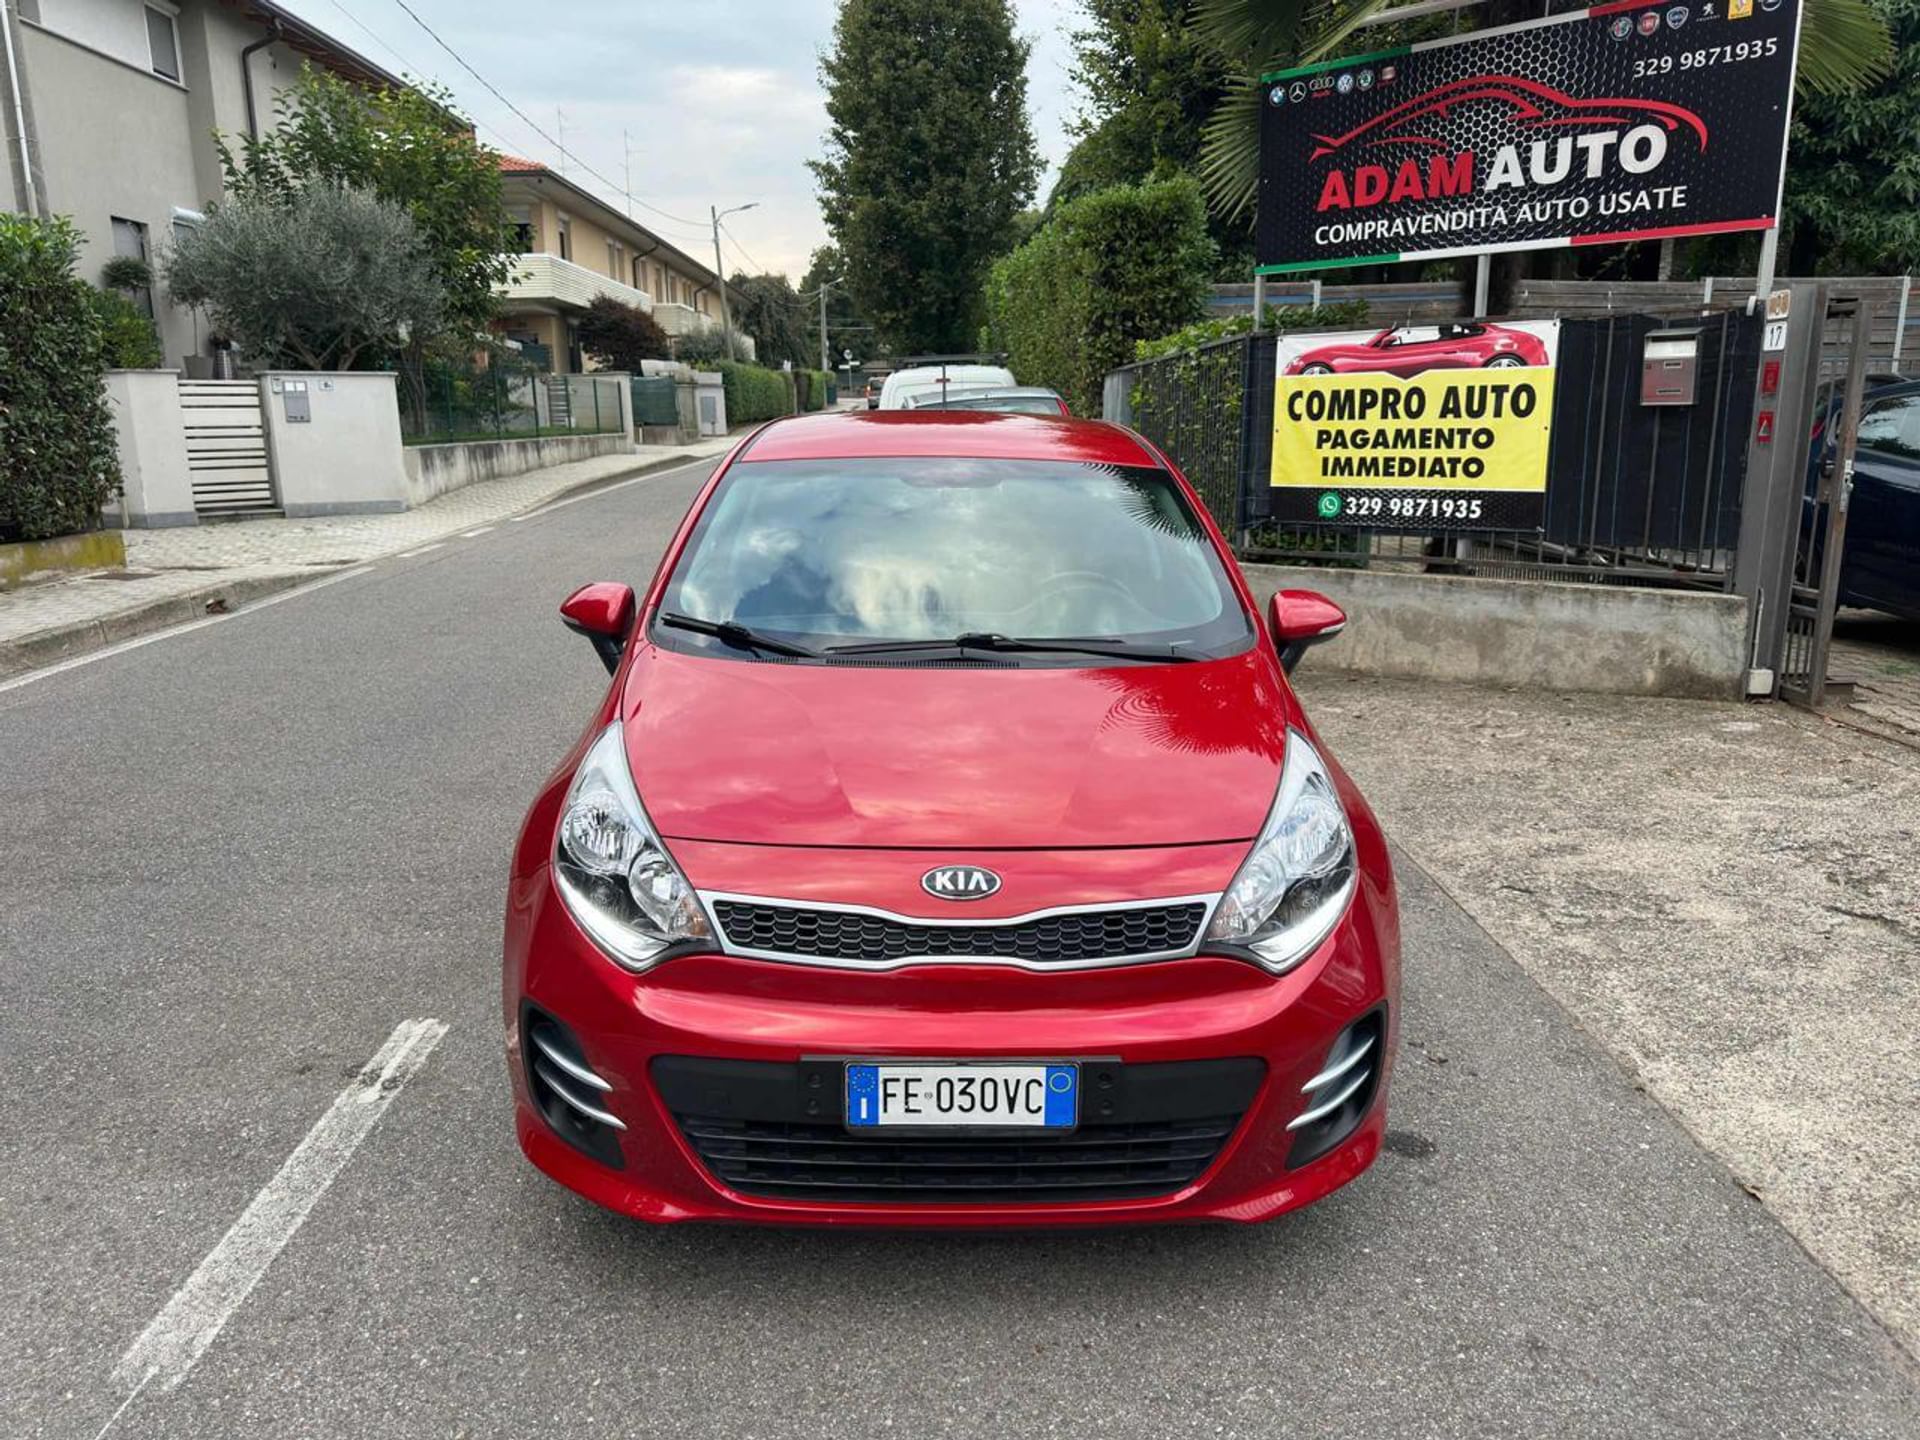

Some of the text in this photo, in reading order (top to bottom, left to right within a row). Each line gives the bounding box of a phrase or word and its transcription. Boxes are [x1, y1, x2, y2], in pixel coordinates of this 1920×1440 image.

[1633, 37, 1777, 78] 329 9871935
[1316, 124, 1668, 212] ADAM AUTO
[1315, 186, 1688, 245] COMPRAVENDITA AUTO USATE
[1769, 325, 1783, 347] 17
[1287, 383, 1536, 421] COMPRO AUTO
[1316, 427, 1495, 450] PAGAMENTO
[1321, 457, 1485, 478] IMMEDIATO
[1346, 497, 1482, 519] 329 9871935
[935, 871, 989, 891] KIA
[882, 1077, 1043, 1114] FE 030VC
